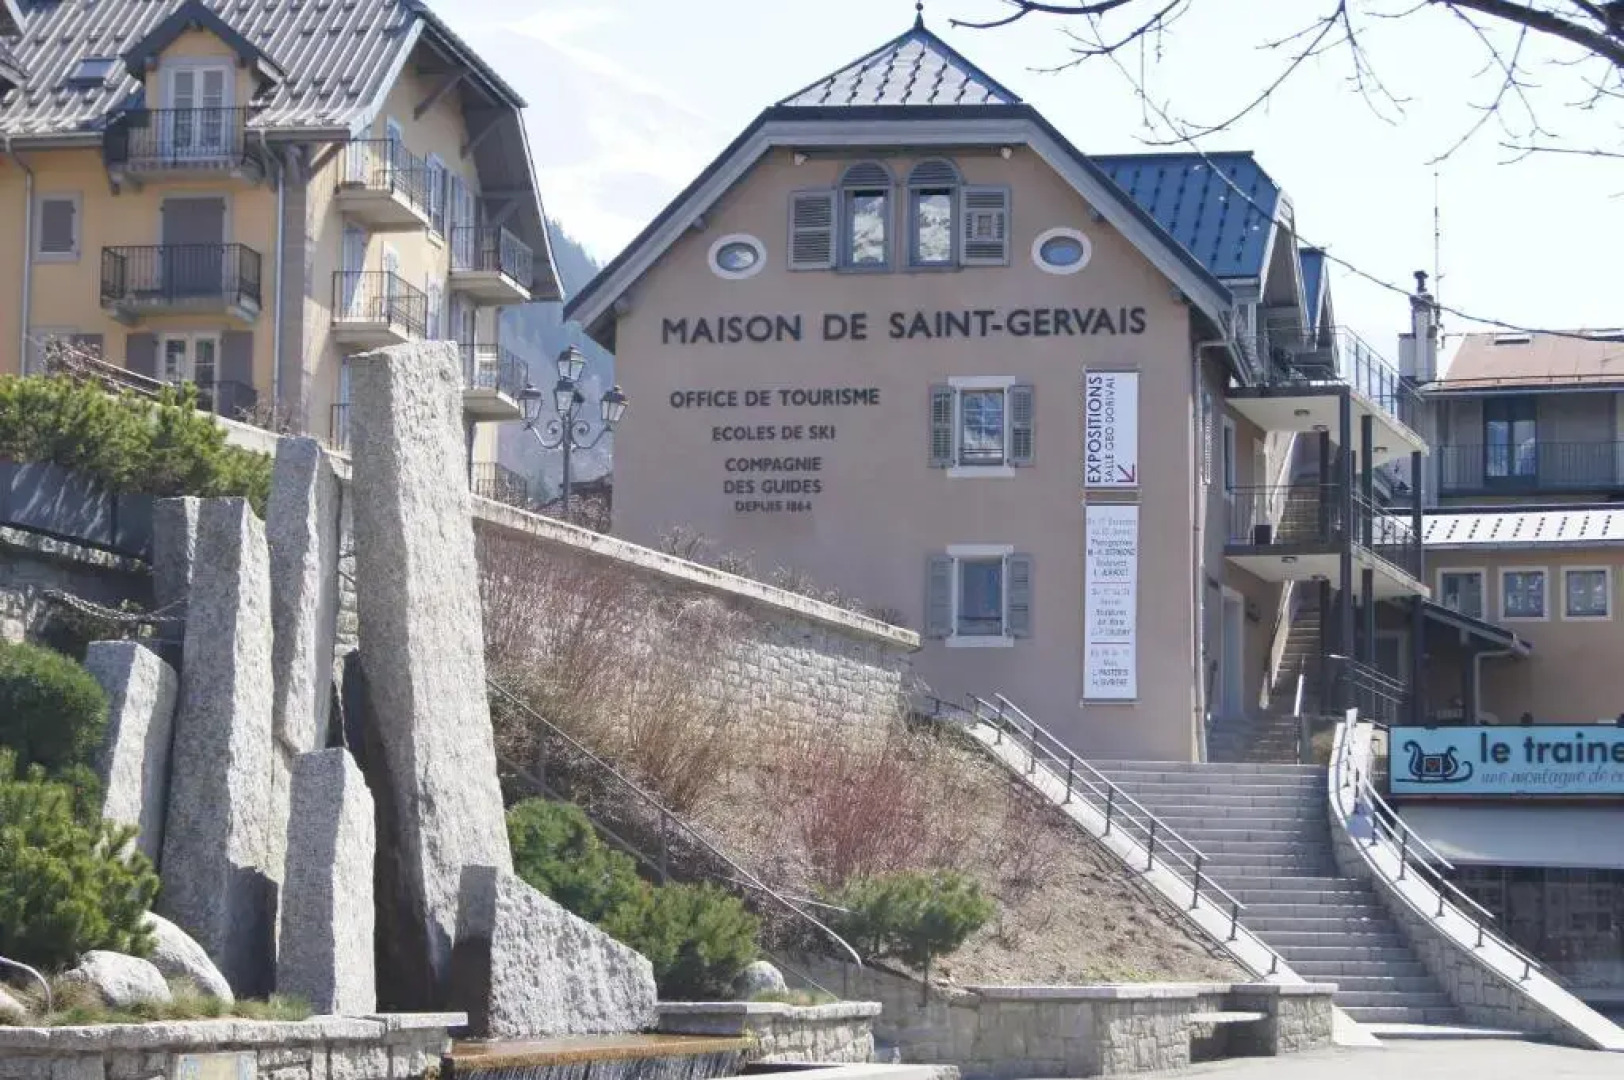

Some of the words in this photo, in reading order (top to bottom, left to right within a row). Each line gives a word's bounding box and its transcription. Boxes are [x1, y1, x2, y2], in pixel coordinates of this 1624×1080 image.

[661, 314, 801, 344] MAISON
[822, 313, 868, 341] DE
[888, 306, 1147, 339] SAINT-GERVAIS
[670, 390, 739, 408] OFFICE
[744, 390, 771, 406] DE
[778, 388, 880, 406] TOURISME
[711, 426, 775, 441] ECOLES
[781, 425, 803, 440] DE
[809, 425, 835, 439] SKI
[1087, 376, 1102, 483] EXPOSITIONS
[724, 457, 822, 471] COMPAGNIE
[1104, 454, 1114, 482] SALLE
[723, 480, 755, 494] DES
[760, 479, 822, 494] GUIDES
[735, 501, 781, 512] DEPUIS
[1480, 732, 1511, 763] le
